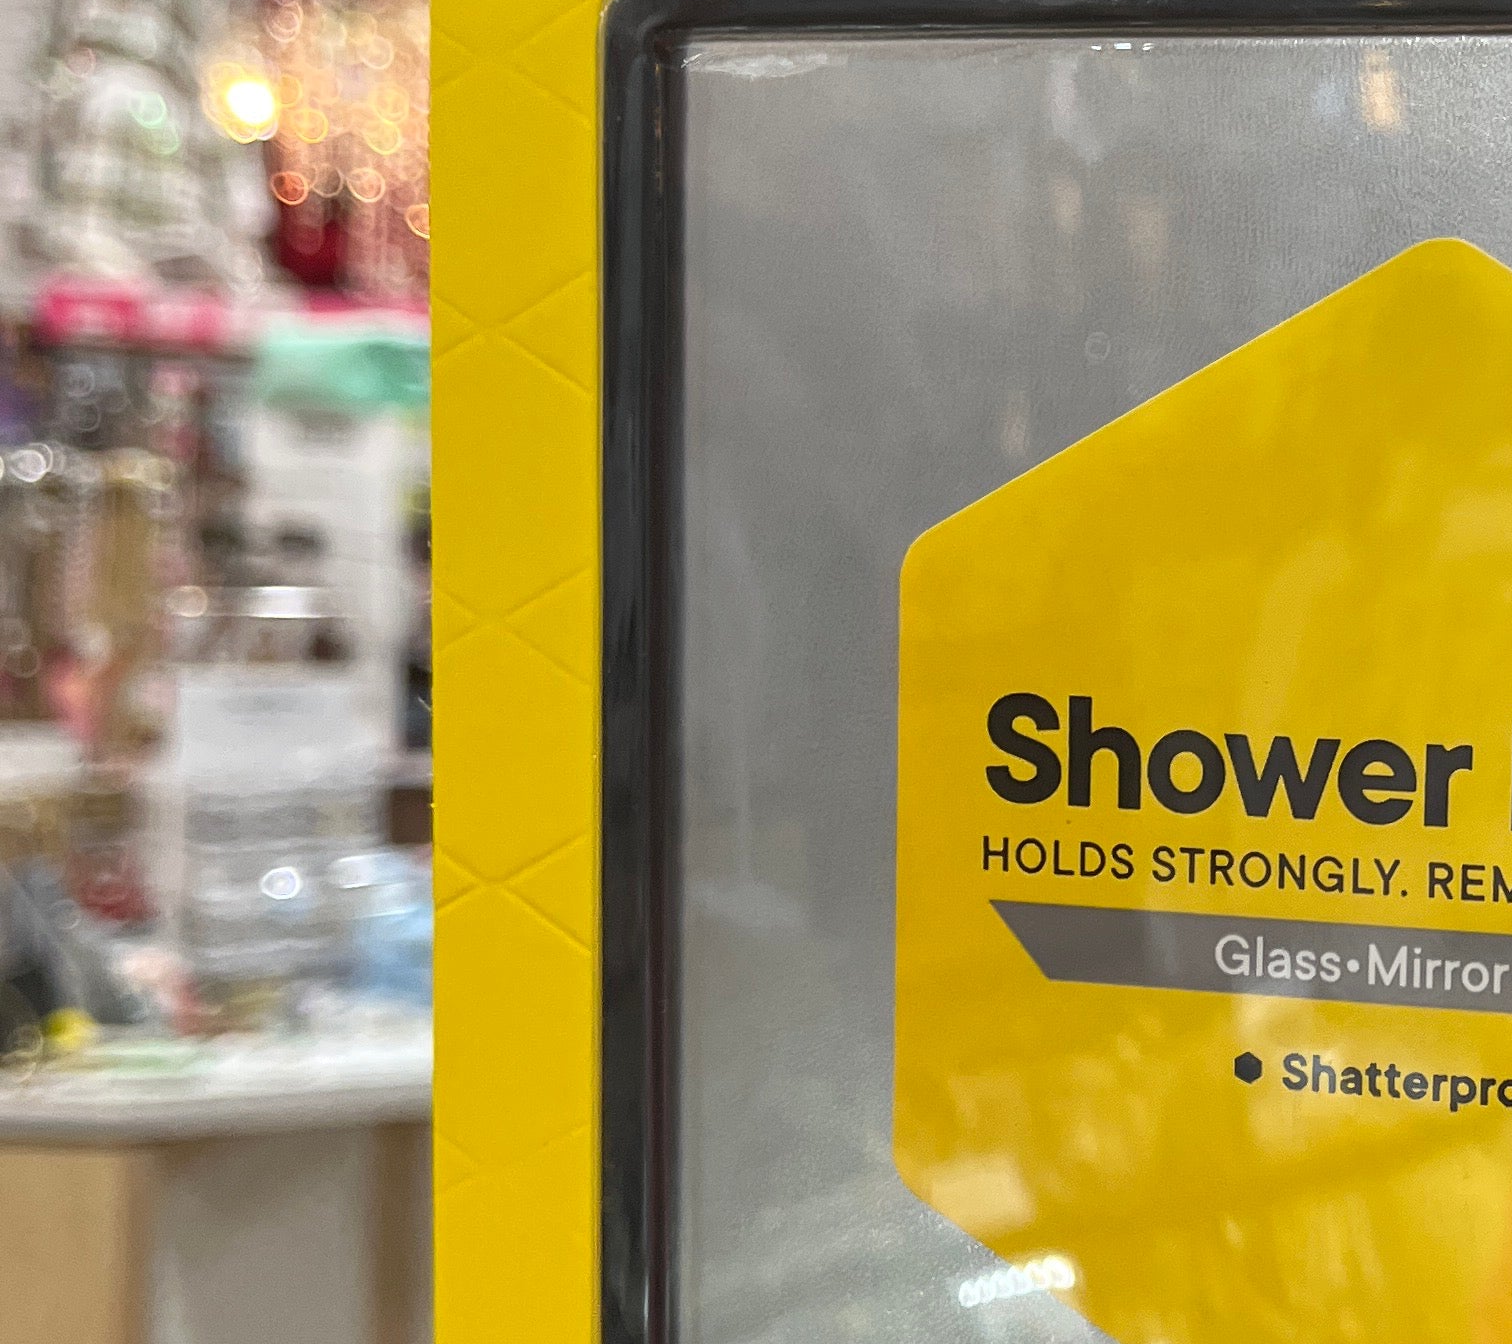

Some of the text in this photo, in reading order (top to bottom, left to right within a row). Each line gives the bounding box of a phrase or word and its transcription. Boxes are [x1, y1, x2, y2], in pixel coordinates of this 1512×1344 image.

[985, 692, 1474, 828] Shower
[982, 835, 1135, 880] HOLDS
[1151, 845, 1409, 898] STRONGLY.
